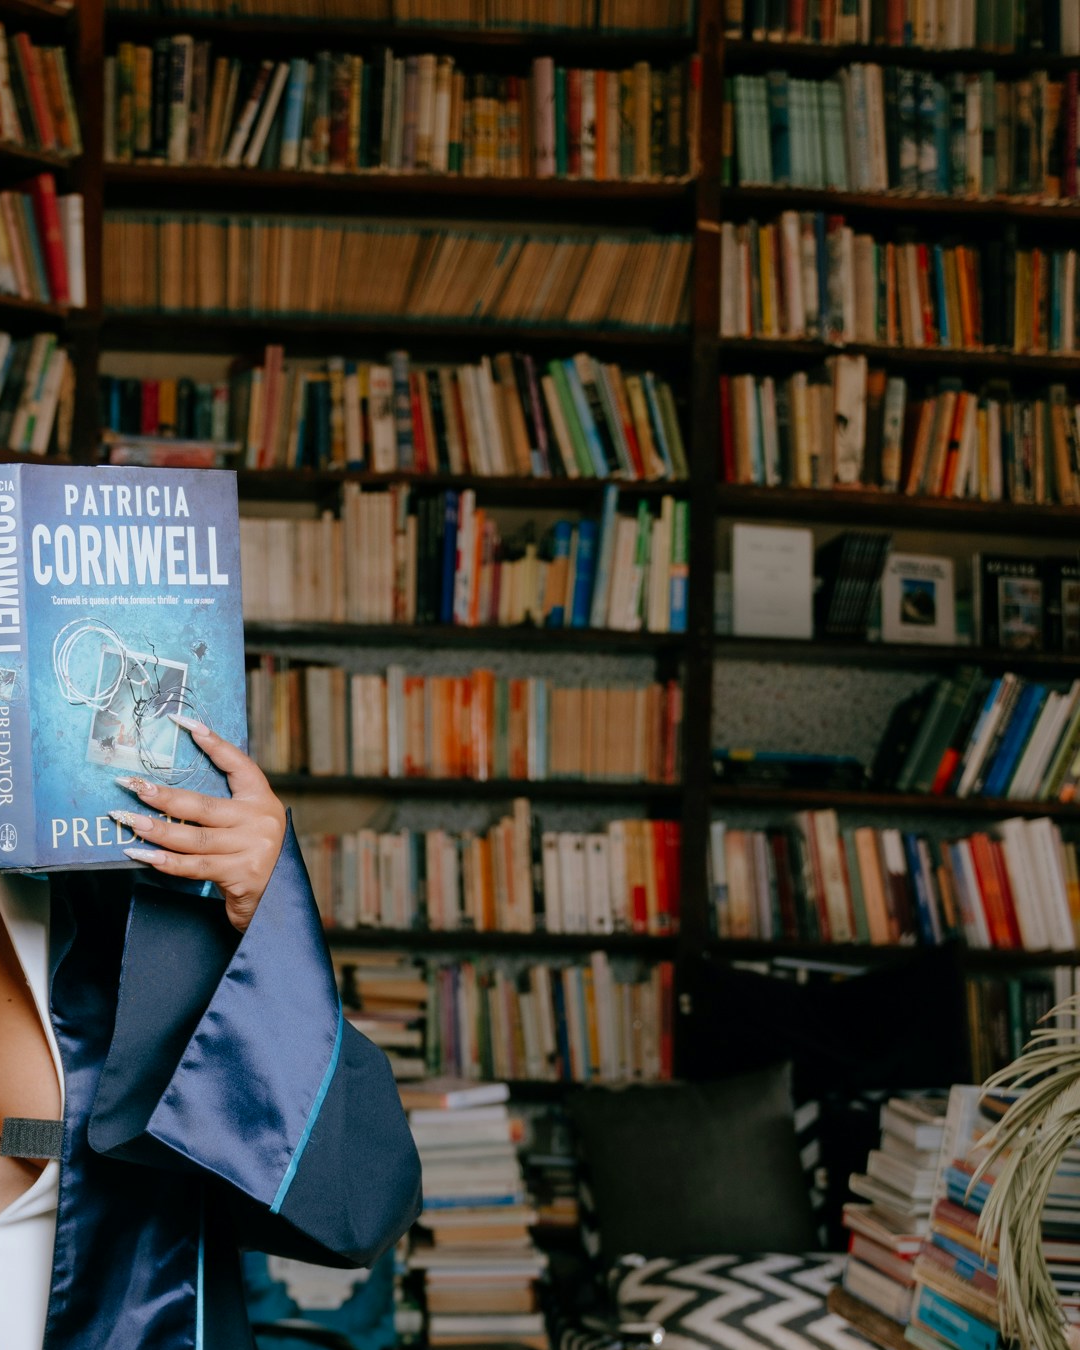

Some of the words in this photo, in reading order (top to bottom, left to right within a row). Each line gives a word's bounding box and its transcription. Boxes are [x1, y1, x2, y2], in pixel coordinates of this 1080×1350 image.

[64, 484, 190, 518] PATRICIA
[31, 524, 229, 586] CORNWELL
[81, 596, 88, 605] is
[89, 597, 109, 607] queen
[110, 595, 118, 605] of
[118, 595, 129, 605] the
[129, 595, 156, 605] forensic
